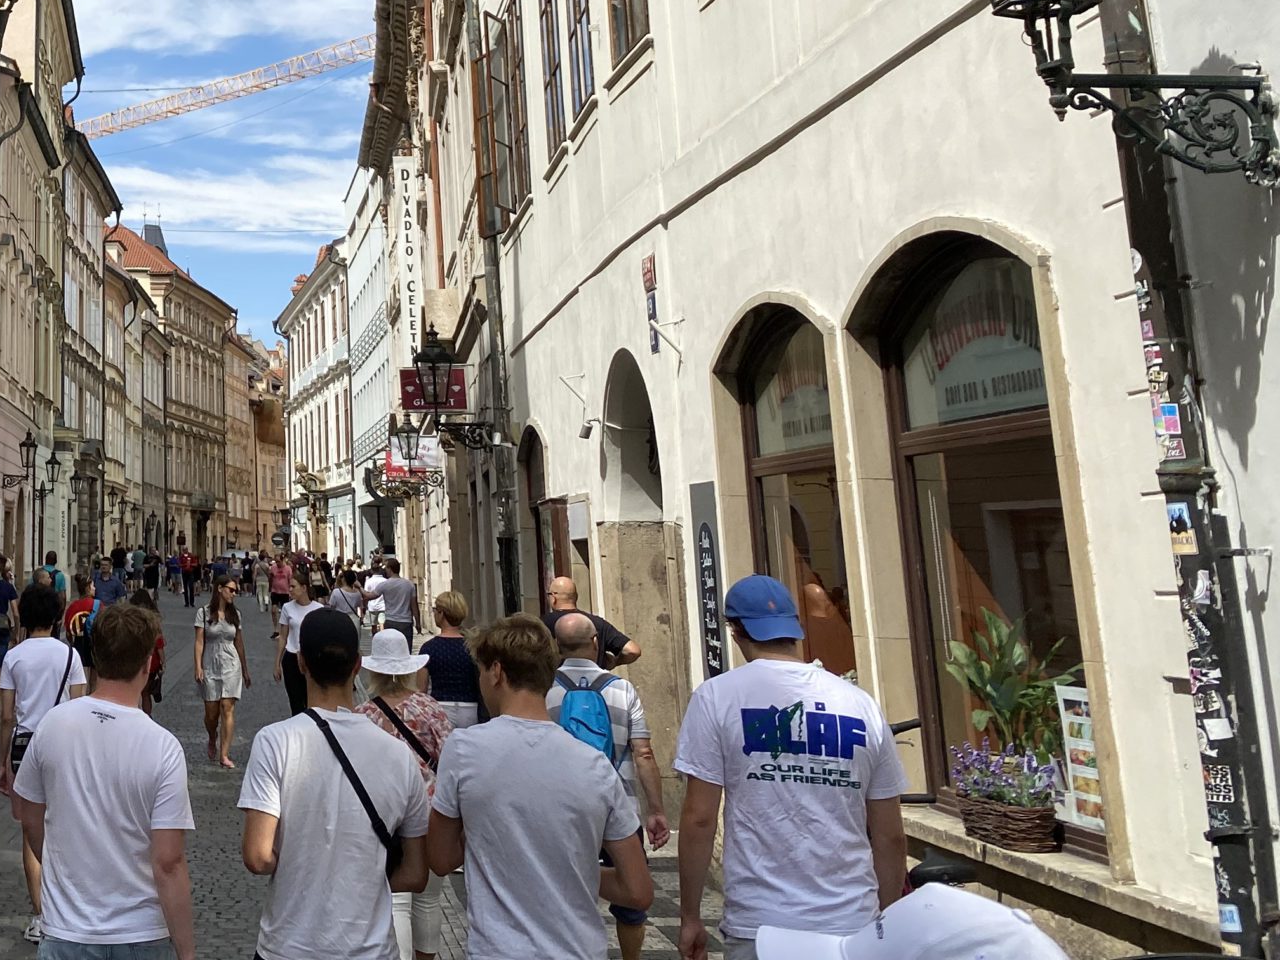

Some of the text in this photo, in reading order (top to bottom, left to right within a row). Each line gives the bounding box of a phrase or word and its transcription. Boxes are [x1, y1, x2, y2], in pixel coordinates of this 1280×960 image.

[400, 168, 414, 257] DIVADLO
[407, 280, 419, 358] CELETN
[760, 763, 852, 779] OUR LIFE
[746, 772, 862, 790] AS FRIENDS
